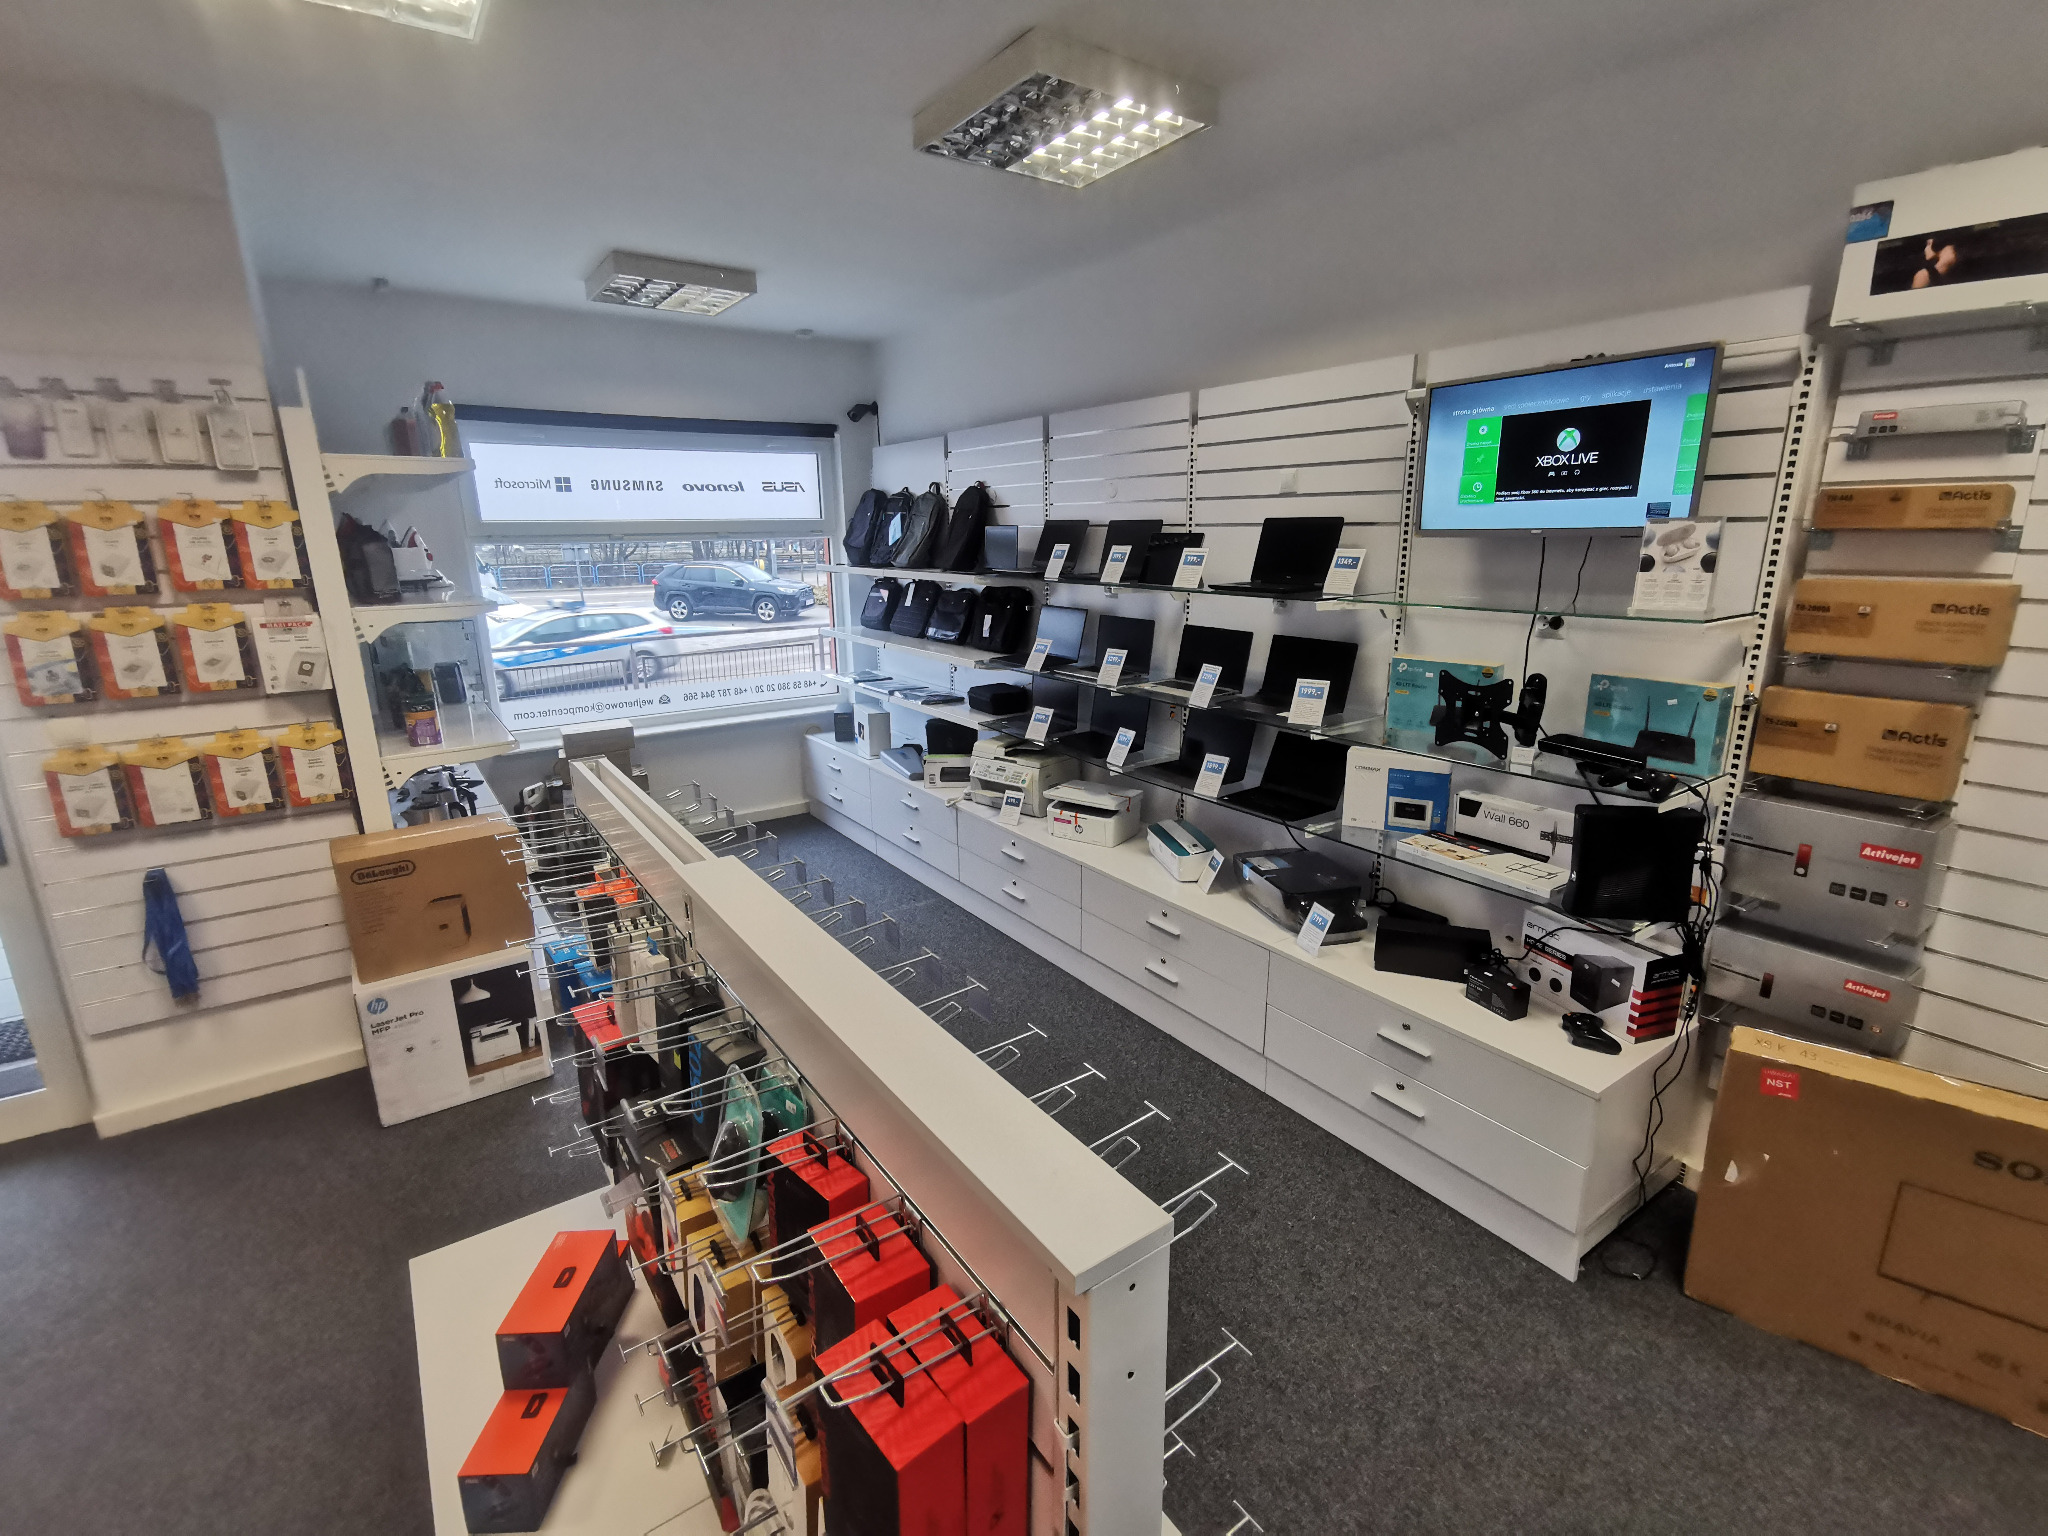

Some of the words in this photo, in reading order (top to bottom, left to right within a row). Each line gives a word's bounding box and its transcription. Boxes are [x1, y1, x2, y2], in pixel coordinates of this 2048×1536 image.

[1535, 453, 1570, 468] XBOX
[1570, 451, 1599, 465] LIVE
[1952, 490, 1992, 501] Actis
[1337, 557, 1357, 567] 1349,-
[1946, 604, 1991, 616] Actis
[1300, 687, 1321, 697] 1999,-
[1898, 730, 1949, 748] Actis
[1483, 810, 1506, 823] Wall
[1508, 816, 1530, 830] 660
[1861, 846, 1917, 865] Activejet
[1844, 981, 1887, 999] Activejet
[370, 998, 386, 1014] hp
[370, 1014, 408, 1029] LaserJet
[409, 1010, 424, 1018] Pro
[371, 1025, 391, 1036] MFP
[1766, 1078, 1792, 1089] NST
[1973, 1149, 2048, 1187] SO
